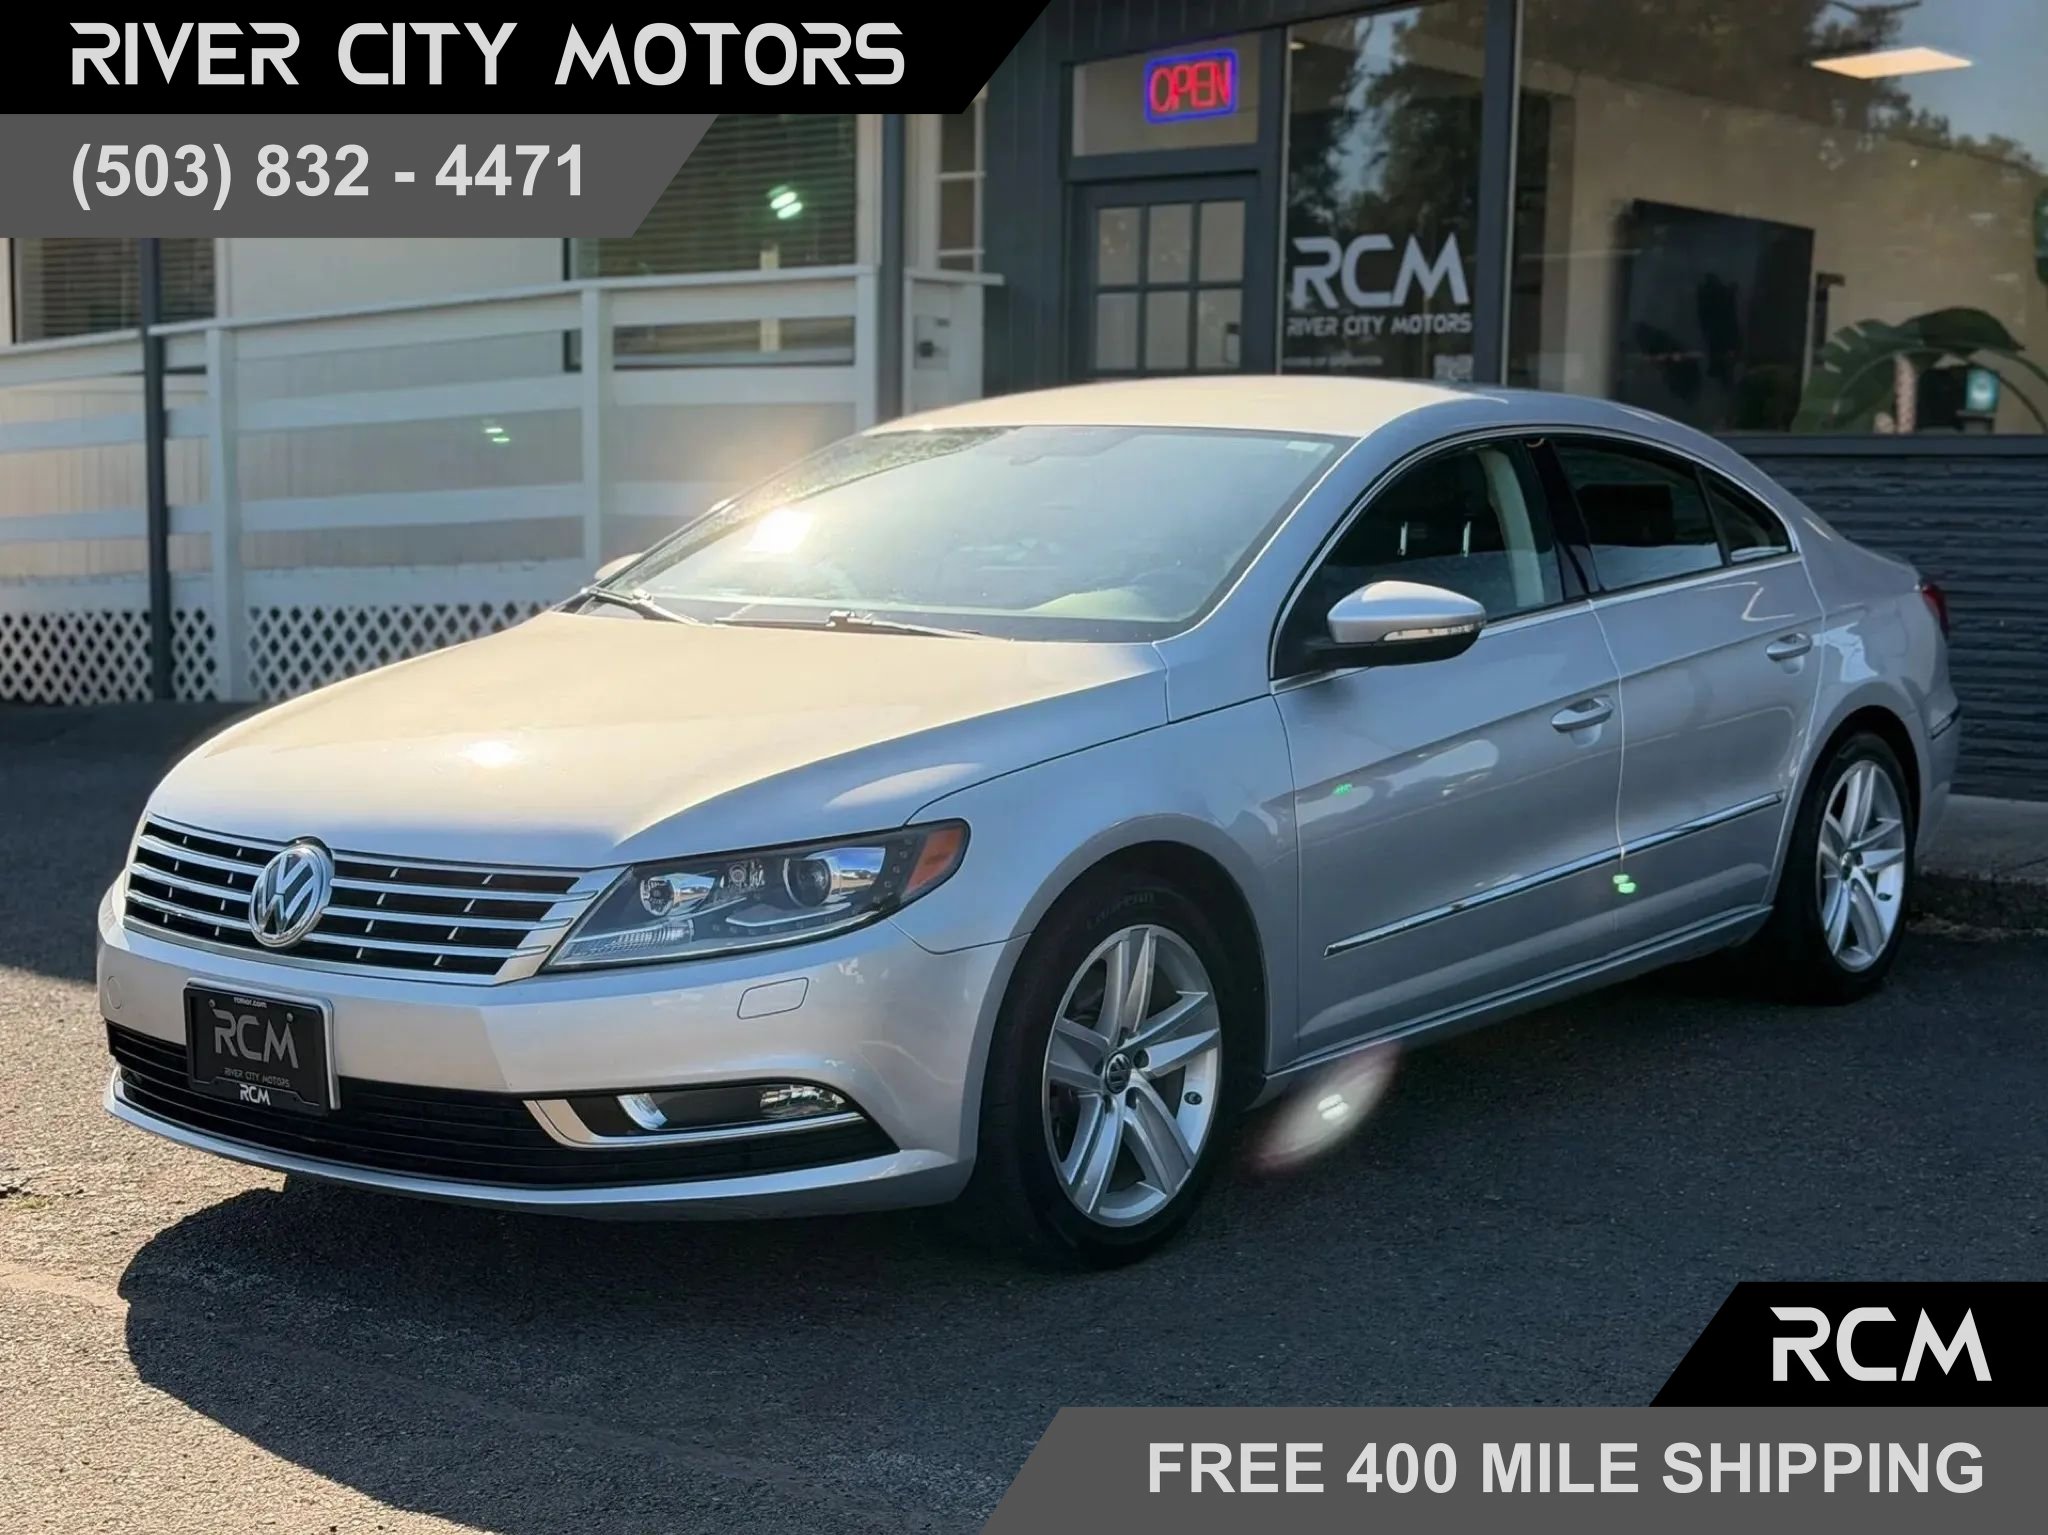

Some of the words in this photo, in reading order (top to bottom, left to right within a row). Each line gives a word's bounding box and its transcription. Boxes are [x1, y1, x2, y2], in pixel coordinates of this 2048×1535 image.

[1150, 58, 1231, 113] OPEN
[1292, 231, 1470, 310] RCM
[1287, 316, 1338, 337] RIVER
[1343, 315, 1385, 336] CITY
[1391, 313, 1473, 335] MOTORS
[212, 1008, 299, 1069] RCM
[224, 1067, 243, 1079] RIVER
[245, 1071, 260, 1081] CITY
[262, 1072, 291, 1088] MOTORS
[239, 1083, 271, 1106] RCM
